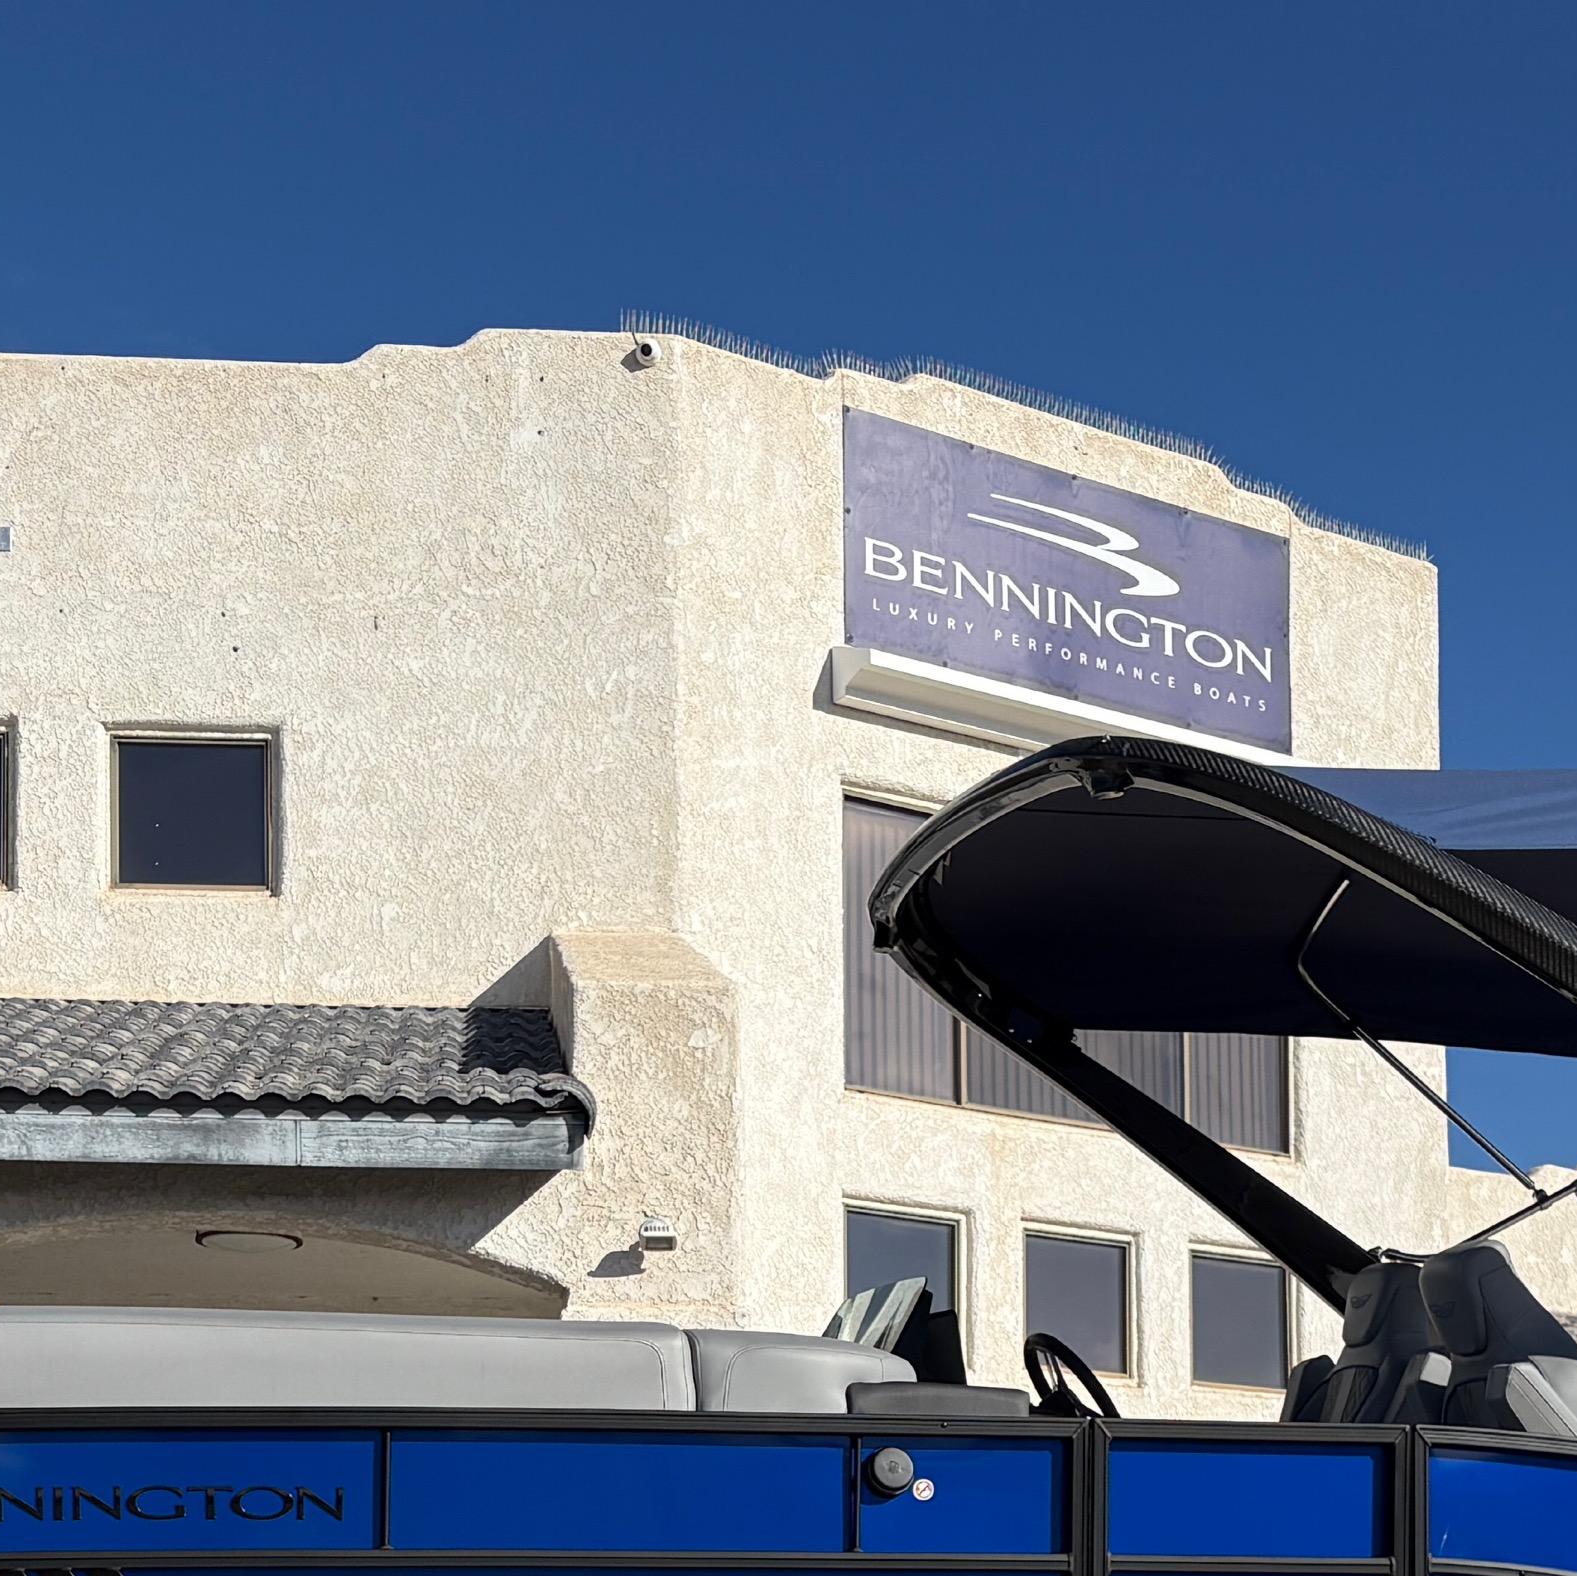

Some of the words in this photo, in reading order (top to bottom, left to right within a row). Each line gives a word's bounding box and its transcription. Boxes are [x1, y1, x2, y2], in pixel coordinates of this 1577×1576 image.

[863, 537, 1273, 683] BENNINGTON
[872, 598, 975, 634] LUXURY
[994, 629, 1177, 689] PERFORMANCE
[1193, 682, 1267, 712] BOATS
